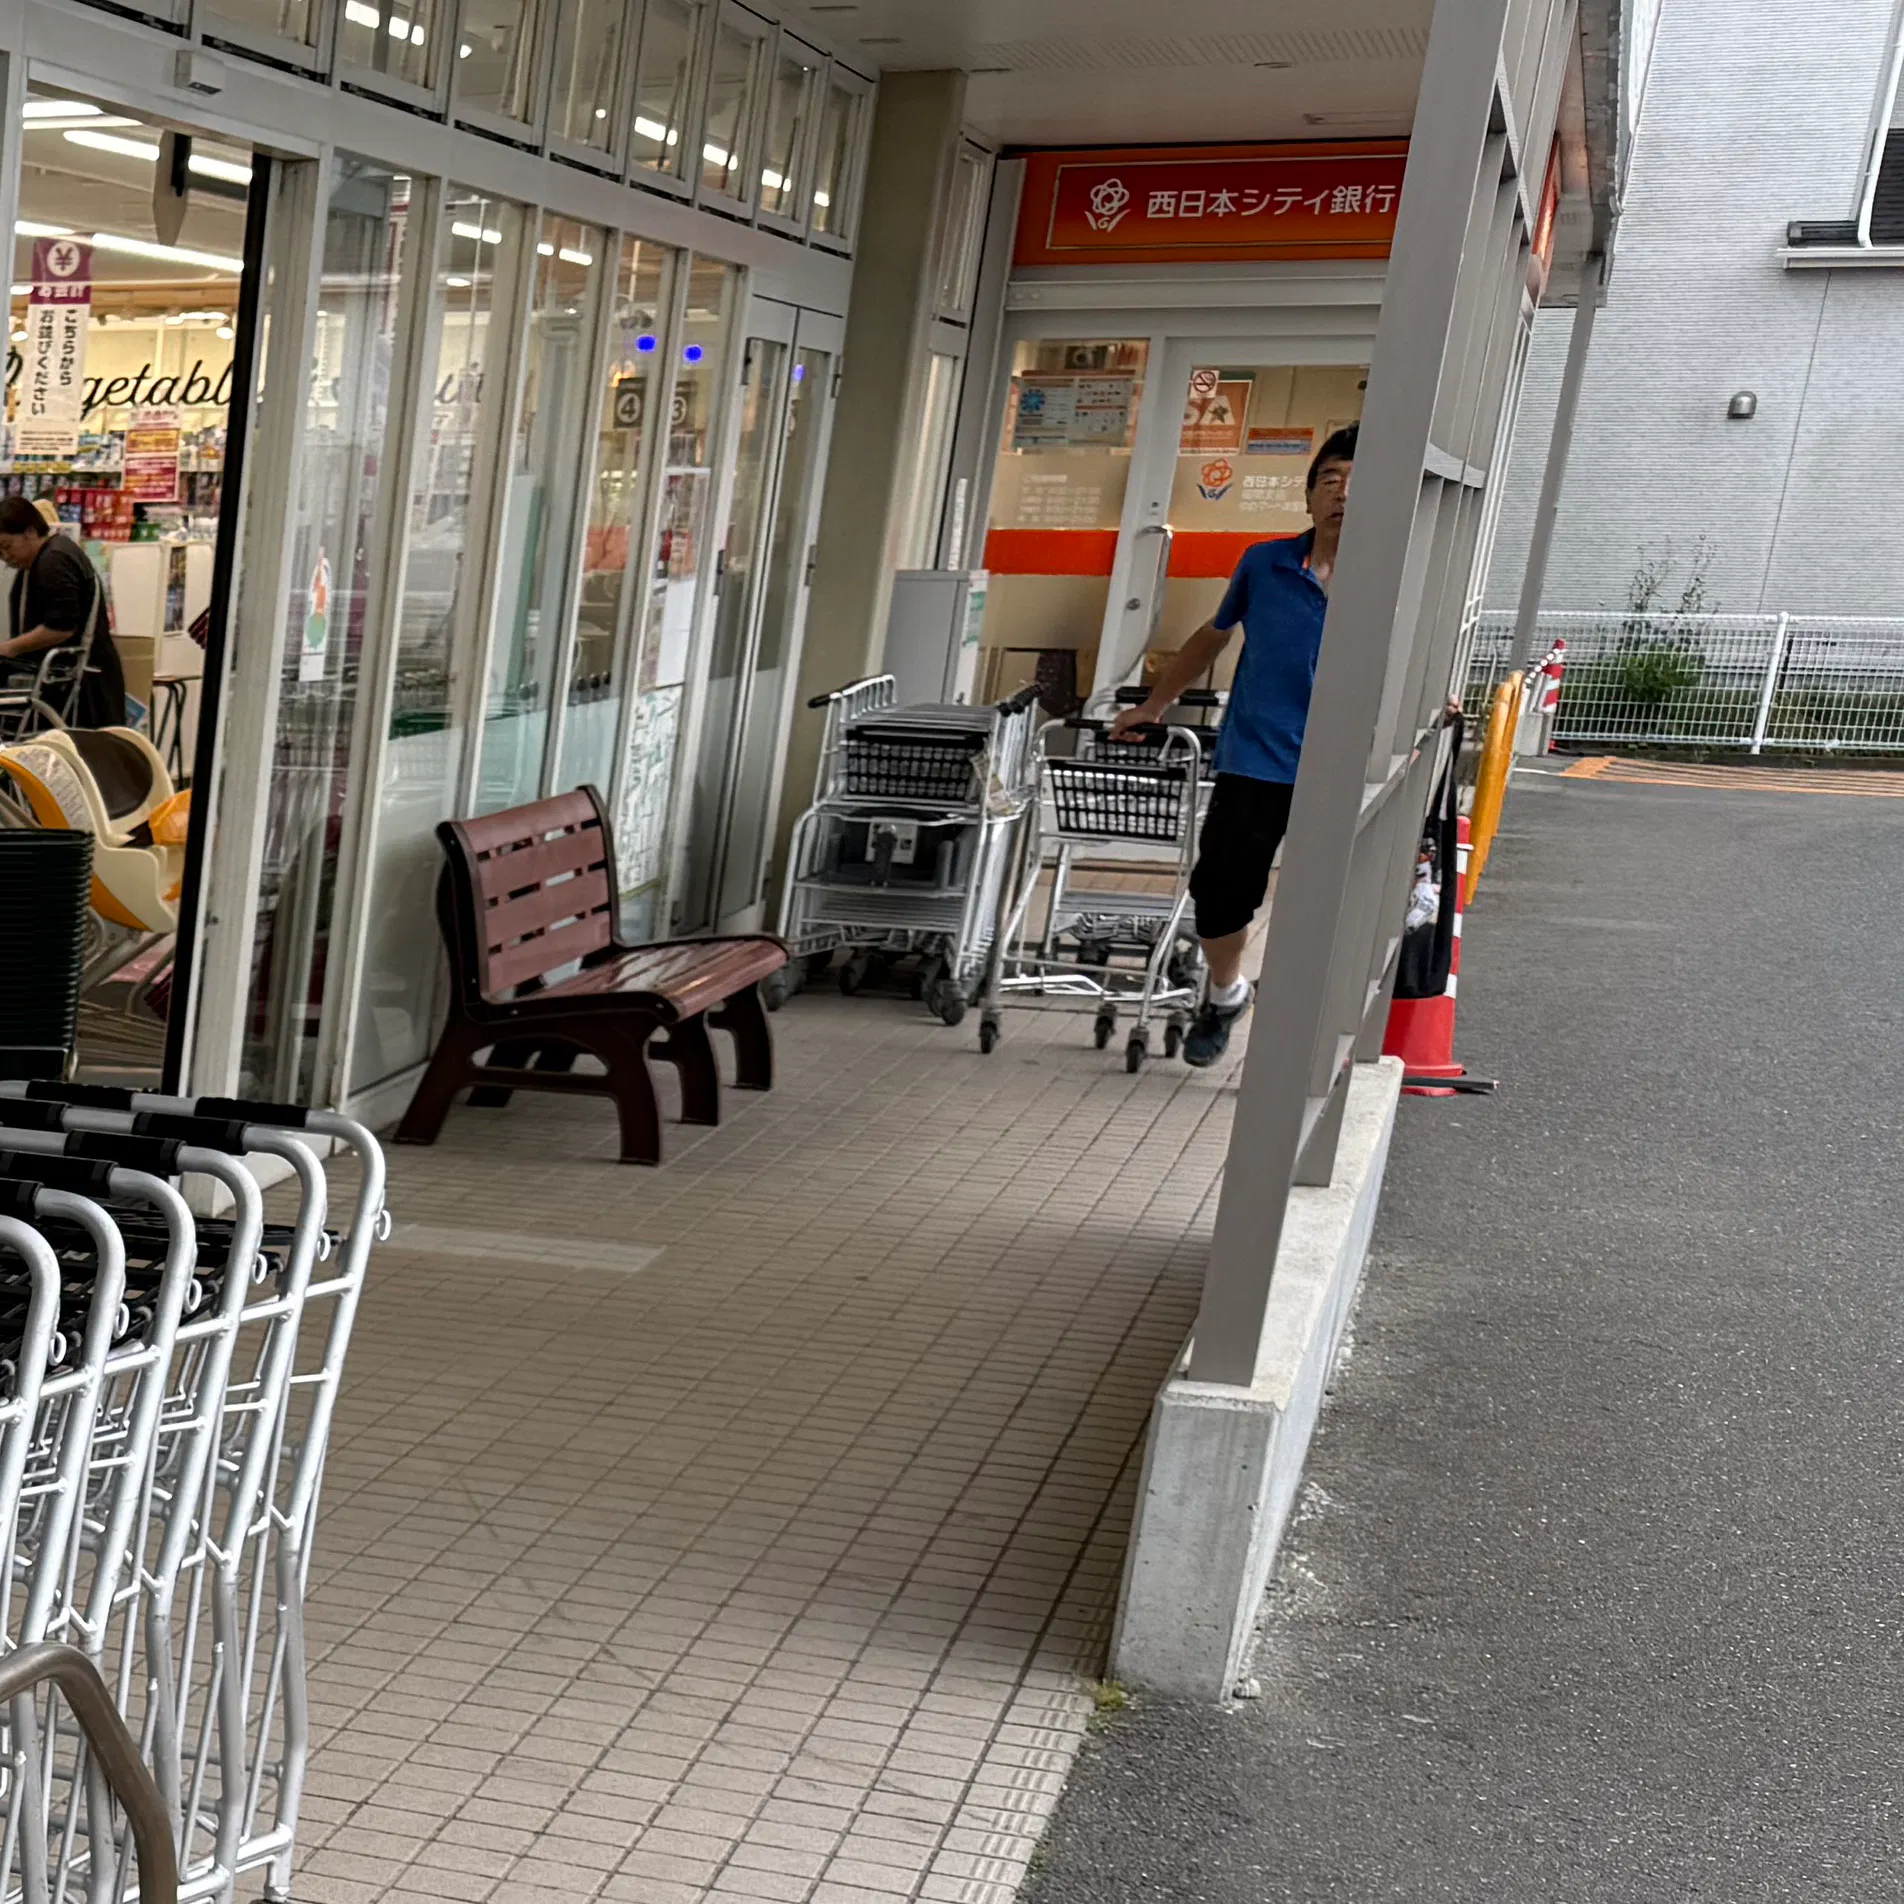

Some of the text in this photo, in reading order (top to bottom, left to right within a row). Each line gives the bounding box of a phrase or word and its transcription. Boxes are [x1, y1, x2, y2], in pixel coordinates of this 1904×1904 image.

[1147, 185, 1396, 218] 西日本シティ銀行
